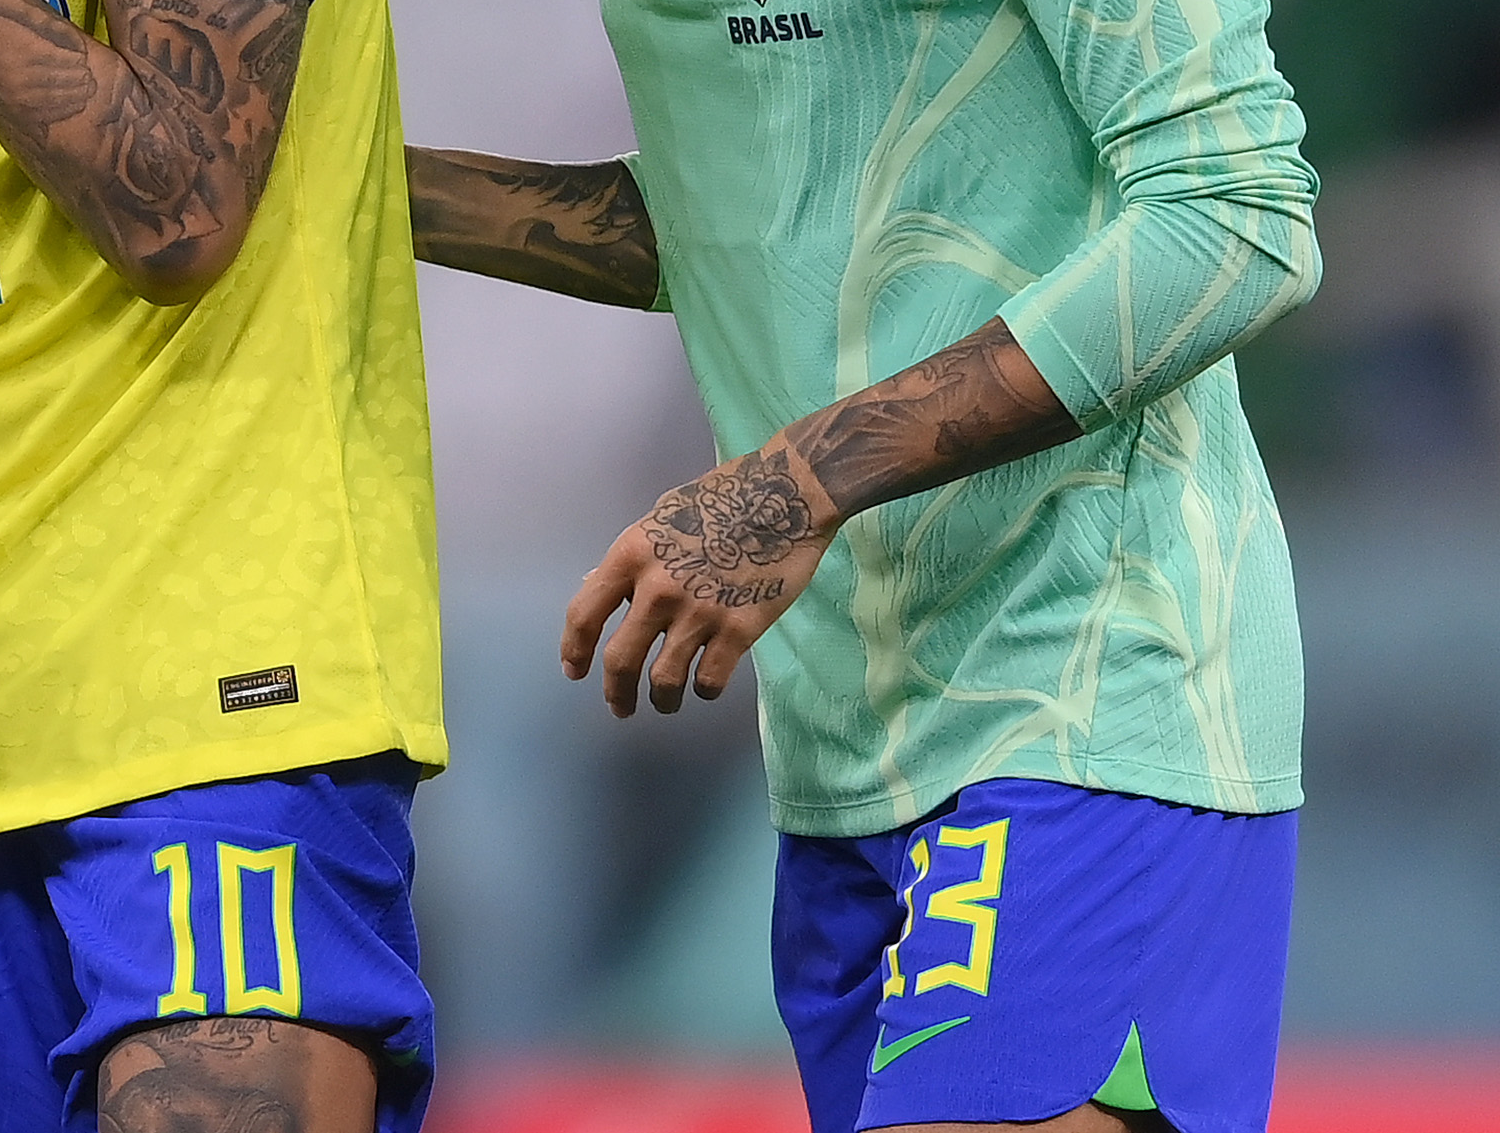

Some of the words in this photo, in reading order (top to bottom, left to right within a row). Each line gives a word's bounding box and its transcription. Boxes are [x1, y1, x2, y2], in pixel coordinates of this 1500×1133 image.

[727, 12, 824, 45] BRASIL
[152, 840, 301, 1019] 10
[882, 817, 1011, 1002] 13
